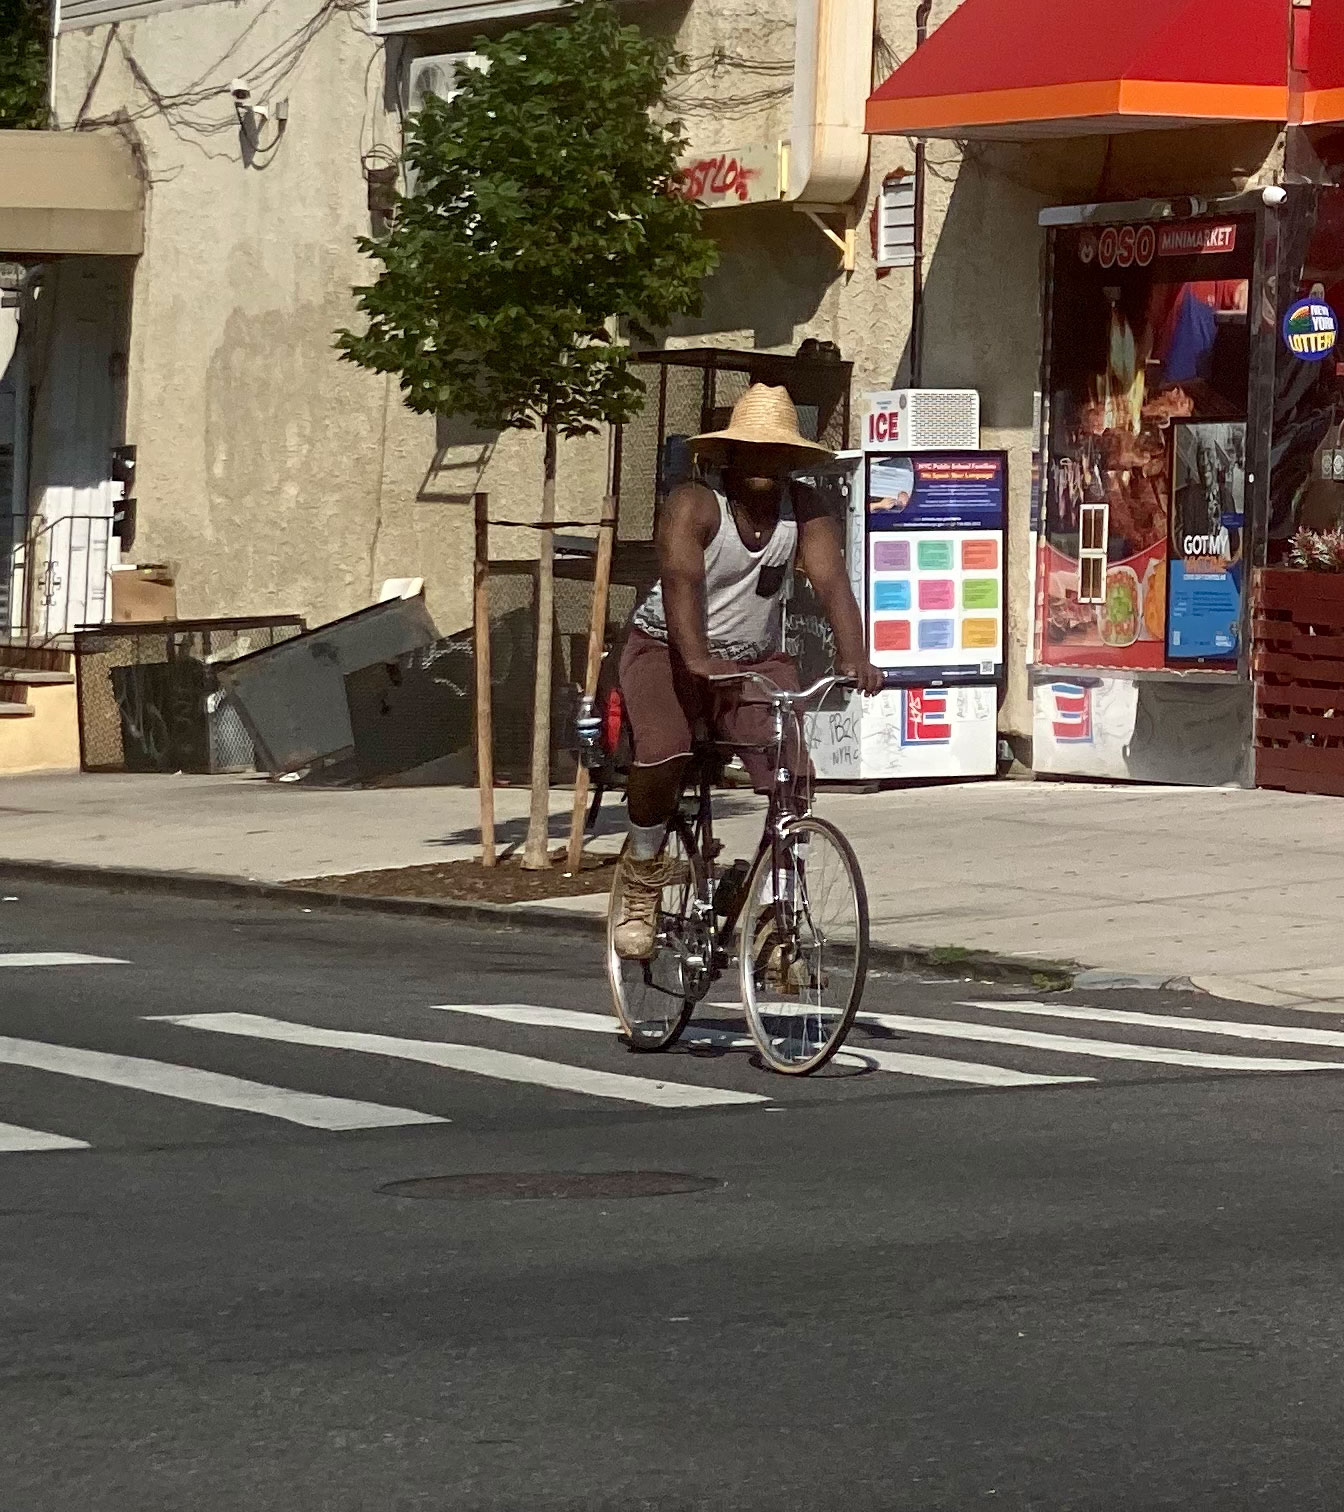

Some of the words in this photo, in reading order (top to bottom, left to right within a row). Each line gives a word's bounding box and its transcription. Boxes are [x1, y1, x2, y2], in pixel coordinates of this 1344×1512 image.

[1098, 224, 1156, 269] OSO
[1161, 226, 1233, 250] MINIMARKET
[1288, 331, 1337, 353] LOTTERY
[869, 411, 899, 443] ICE
[1183, 534, 1208, 555] GOT
[1208, 534, 1229, 555] MY
